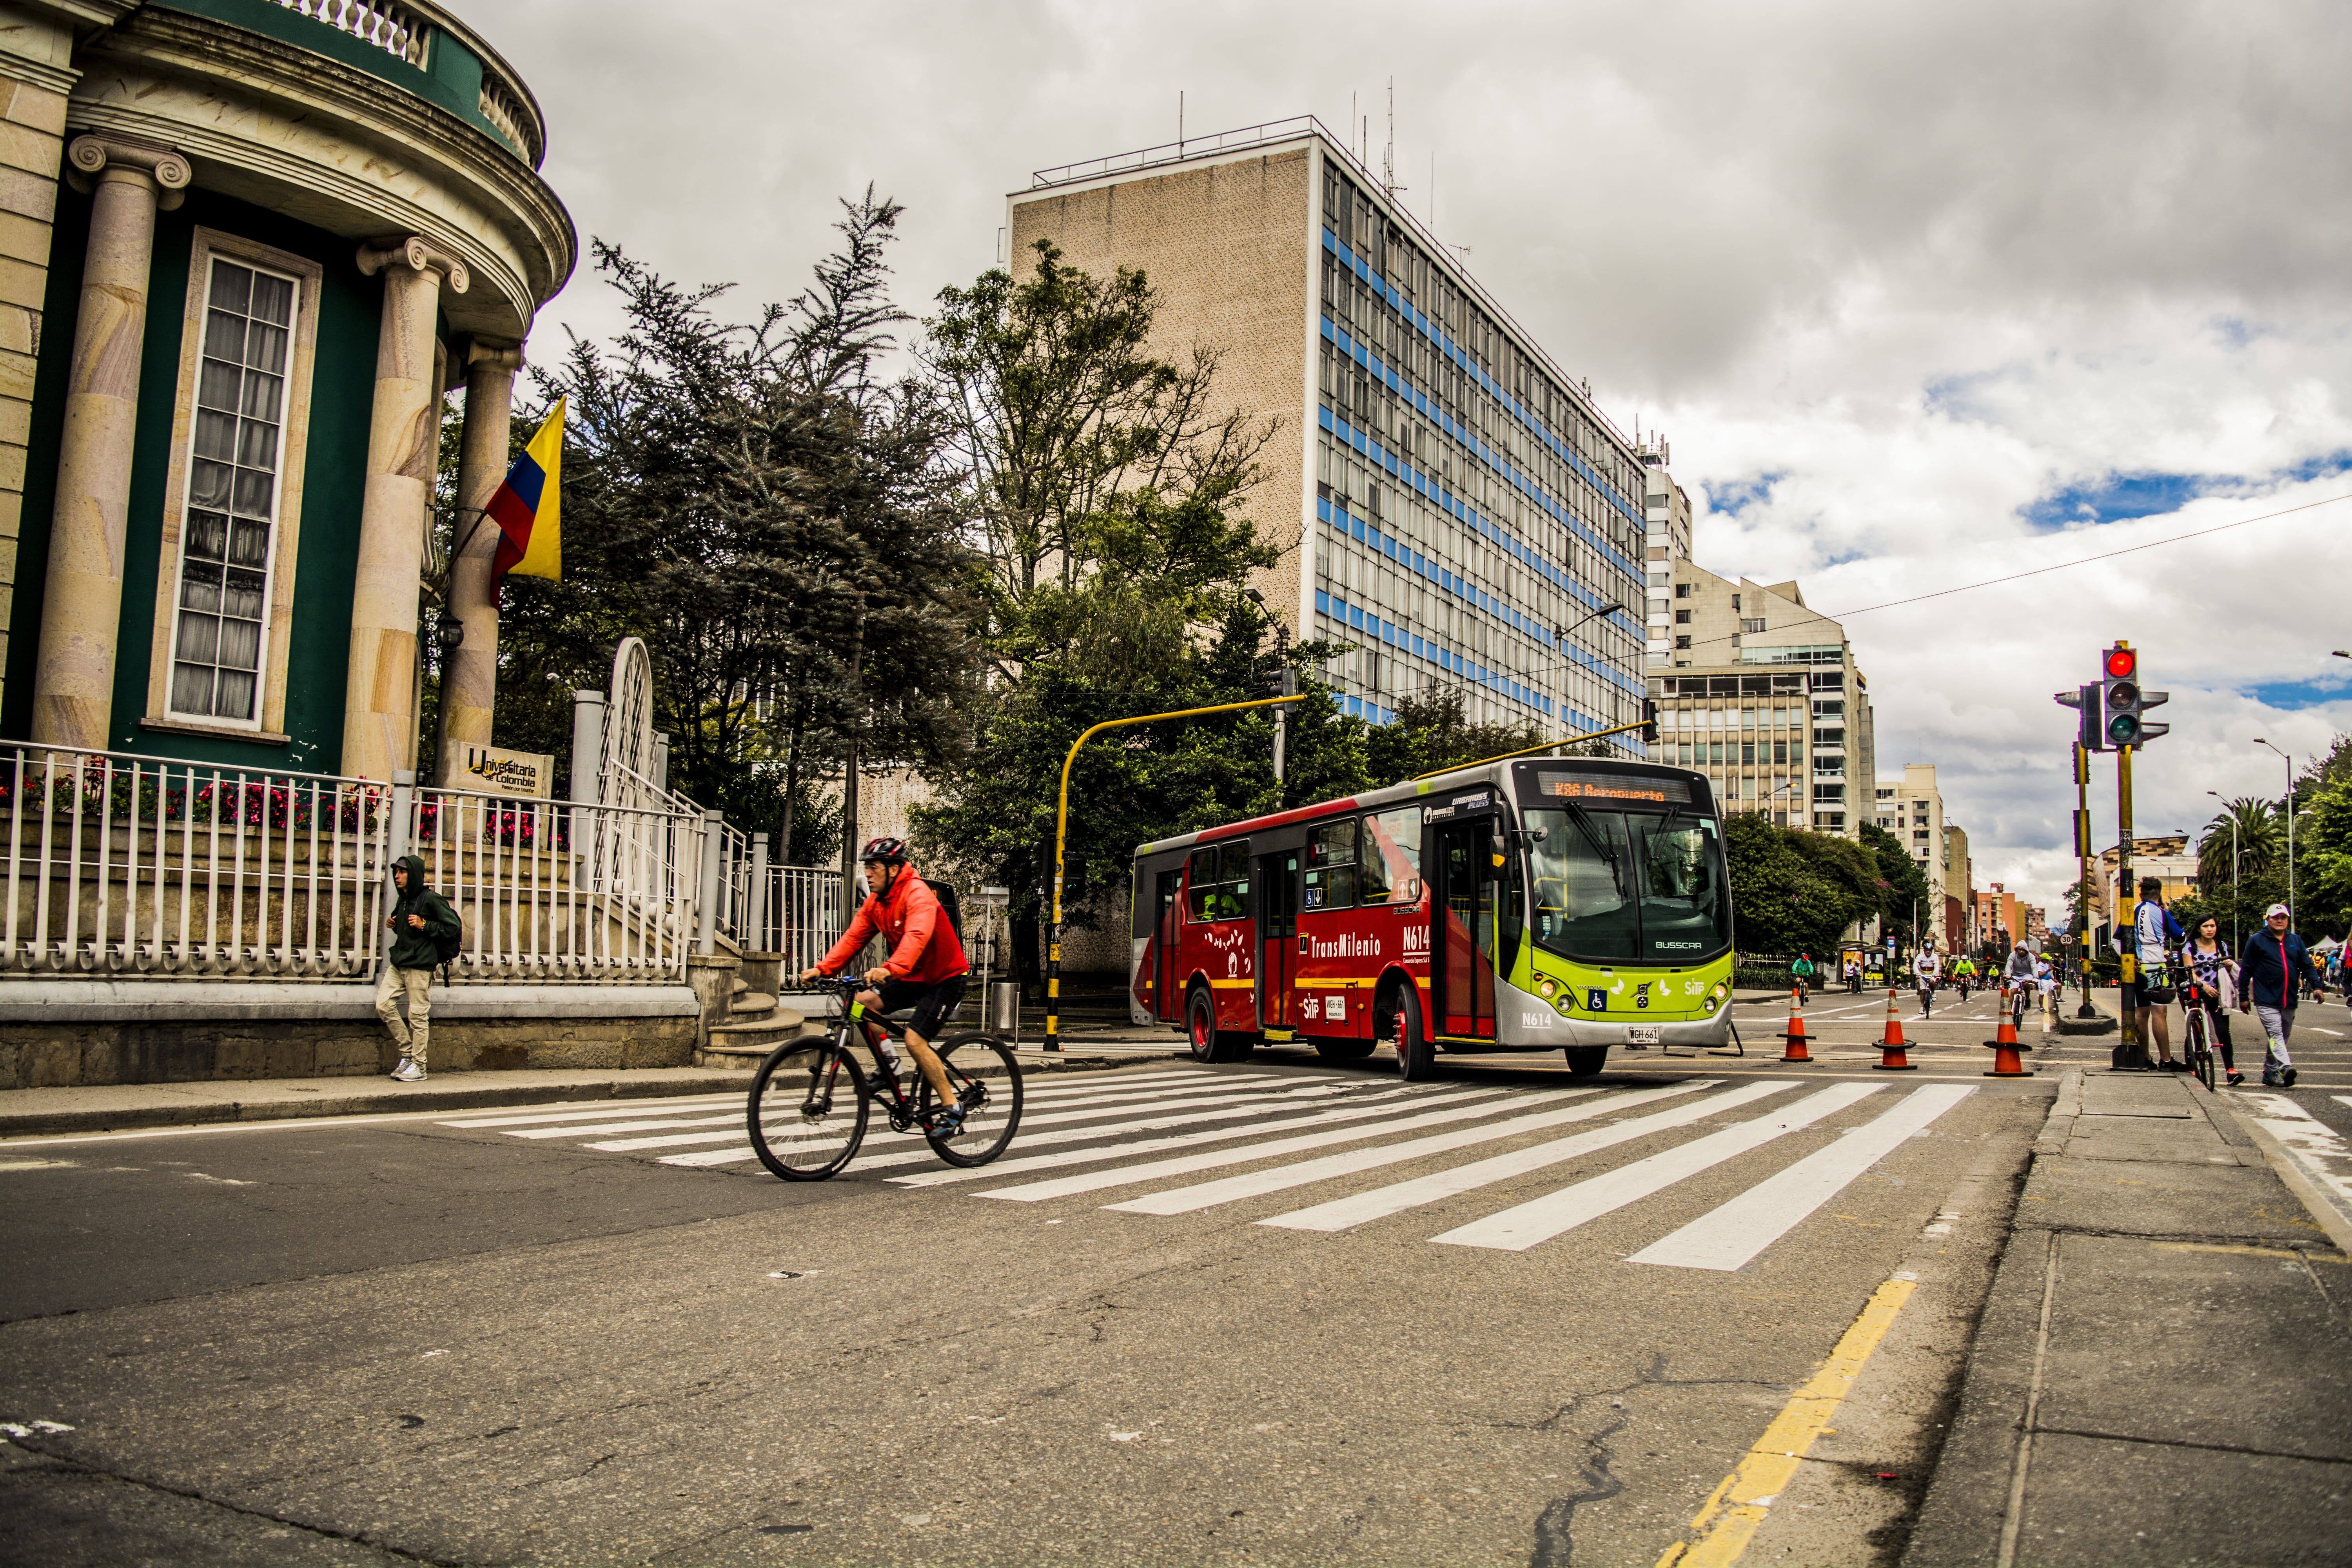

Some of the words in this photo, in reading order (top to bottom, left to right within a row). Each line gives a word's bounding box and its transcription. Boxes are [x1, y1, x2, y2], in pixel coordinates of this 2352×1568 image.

[469, 748, 535, 777] Universitaria
[496, 774, 535, 788] Colombia
[1555, 782, 1581, 797] K86
[1452, 792, 1488, 806] URBANUSS
[1467, 798, 1490, 809] PLUSS
[1394, 906, 1420, 915] BUSSCAR
[1312, 932, 1380, 958] TransMilenio
[1403, 926, 1430, 950] N614
[1523, 1013, 1551, 1026] N614
